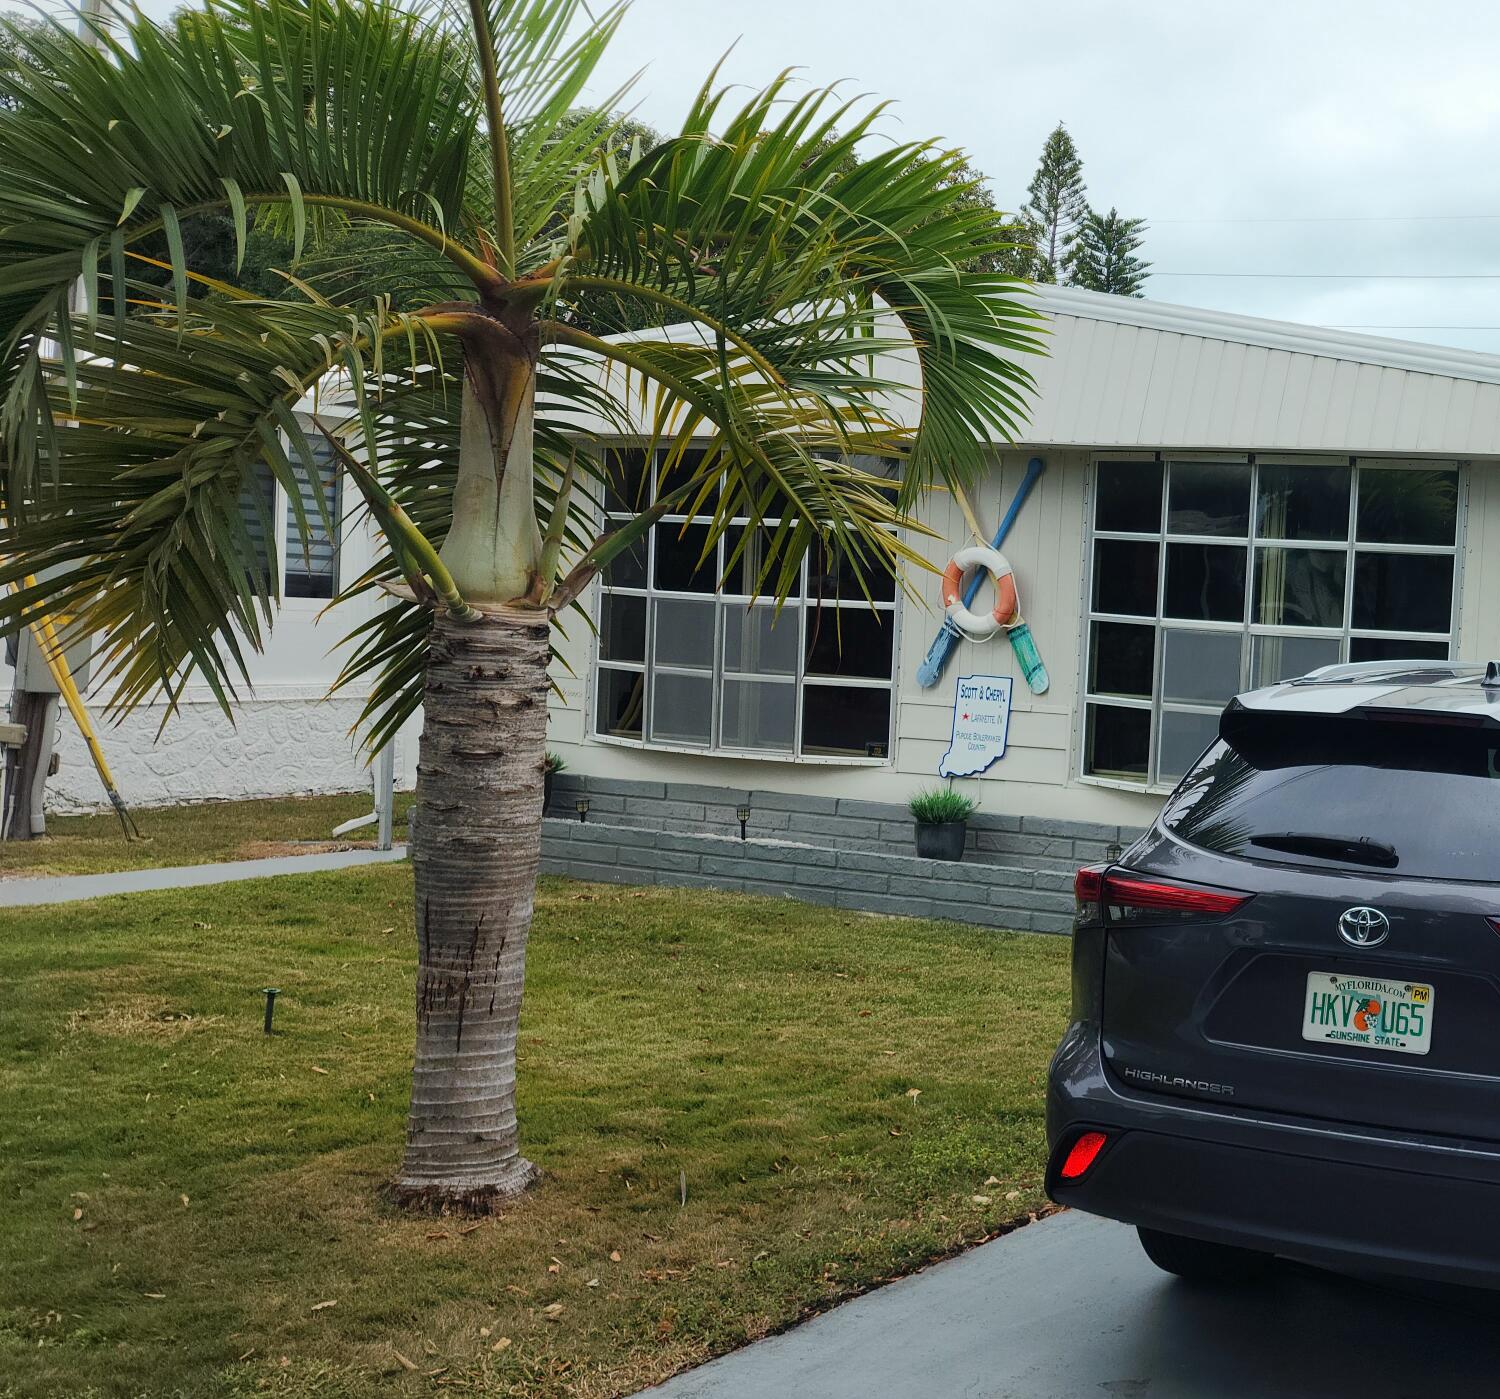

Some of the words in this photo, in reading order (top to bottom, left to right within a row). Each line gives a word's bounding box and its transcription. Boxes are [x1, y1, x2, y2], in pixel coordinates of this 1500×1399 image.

[960, 684, 978, 699] SCOTT
[979, 686, 984, 700] &
[985, 686, 1006, 702] CHERYL
[1335, 980, 1406, 999] MYFLORIDA.COM
[1413, 989, 1428, 1001] PM
[1310, 991, 1354, 1027] HKV
[1381, 1000, 1425, 1036] U65
[1330, 1030, 1370, 1044] SUNSHINE
[1374, 1036, 1401, 1047] STATE
[1124, 1067, 1235, 1096] HIGHLANDER
